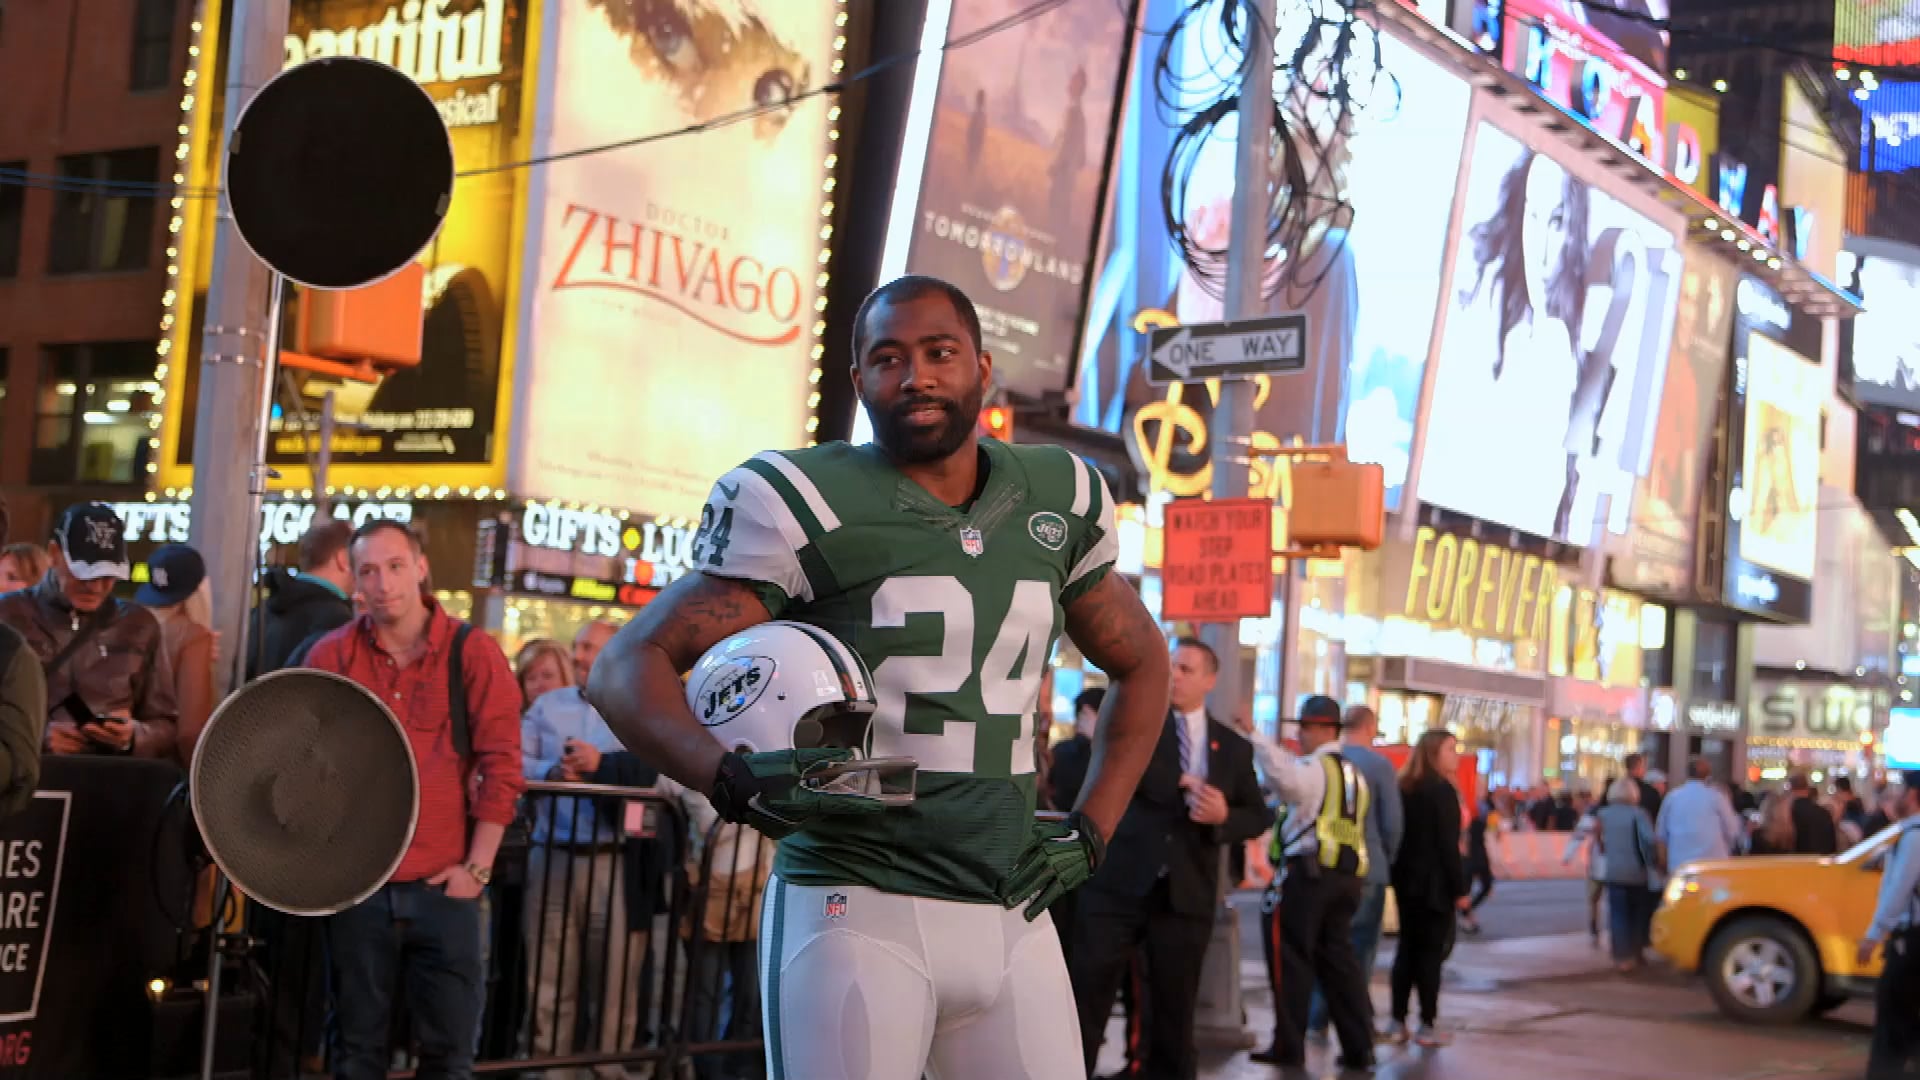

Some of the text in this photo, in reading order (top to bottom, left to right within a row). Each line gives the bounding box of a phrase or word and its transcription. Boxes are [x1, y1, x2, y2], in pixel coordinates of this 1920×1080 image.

[552, 202, 801, 323] ZHIVAGO
[1169, 333, 1292, 366] ONE WAY
[523, 503, 621, 557] GIFTS
[1405, 525, 1558, 641] FOREVER
[704, 666, 761, 720] JETS
[870, 575, 1055, 775] 24
[0, 840, 43, 878] ES
[0, 943, 30, 972] CE
